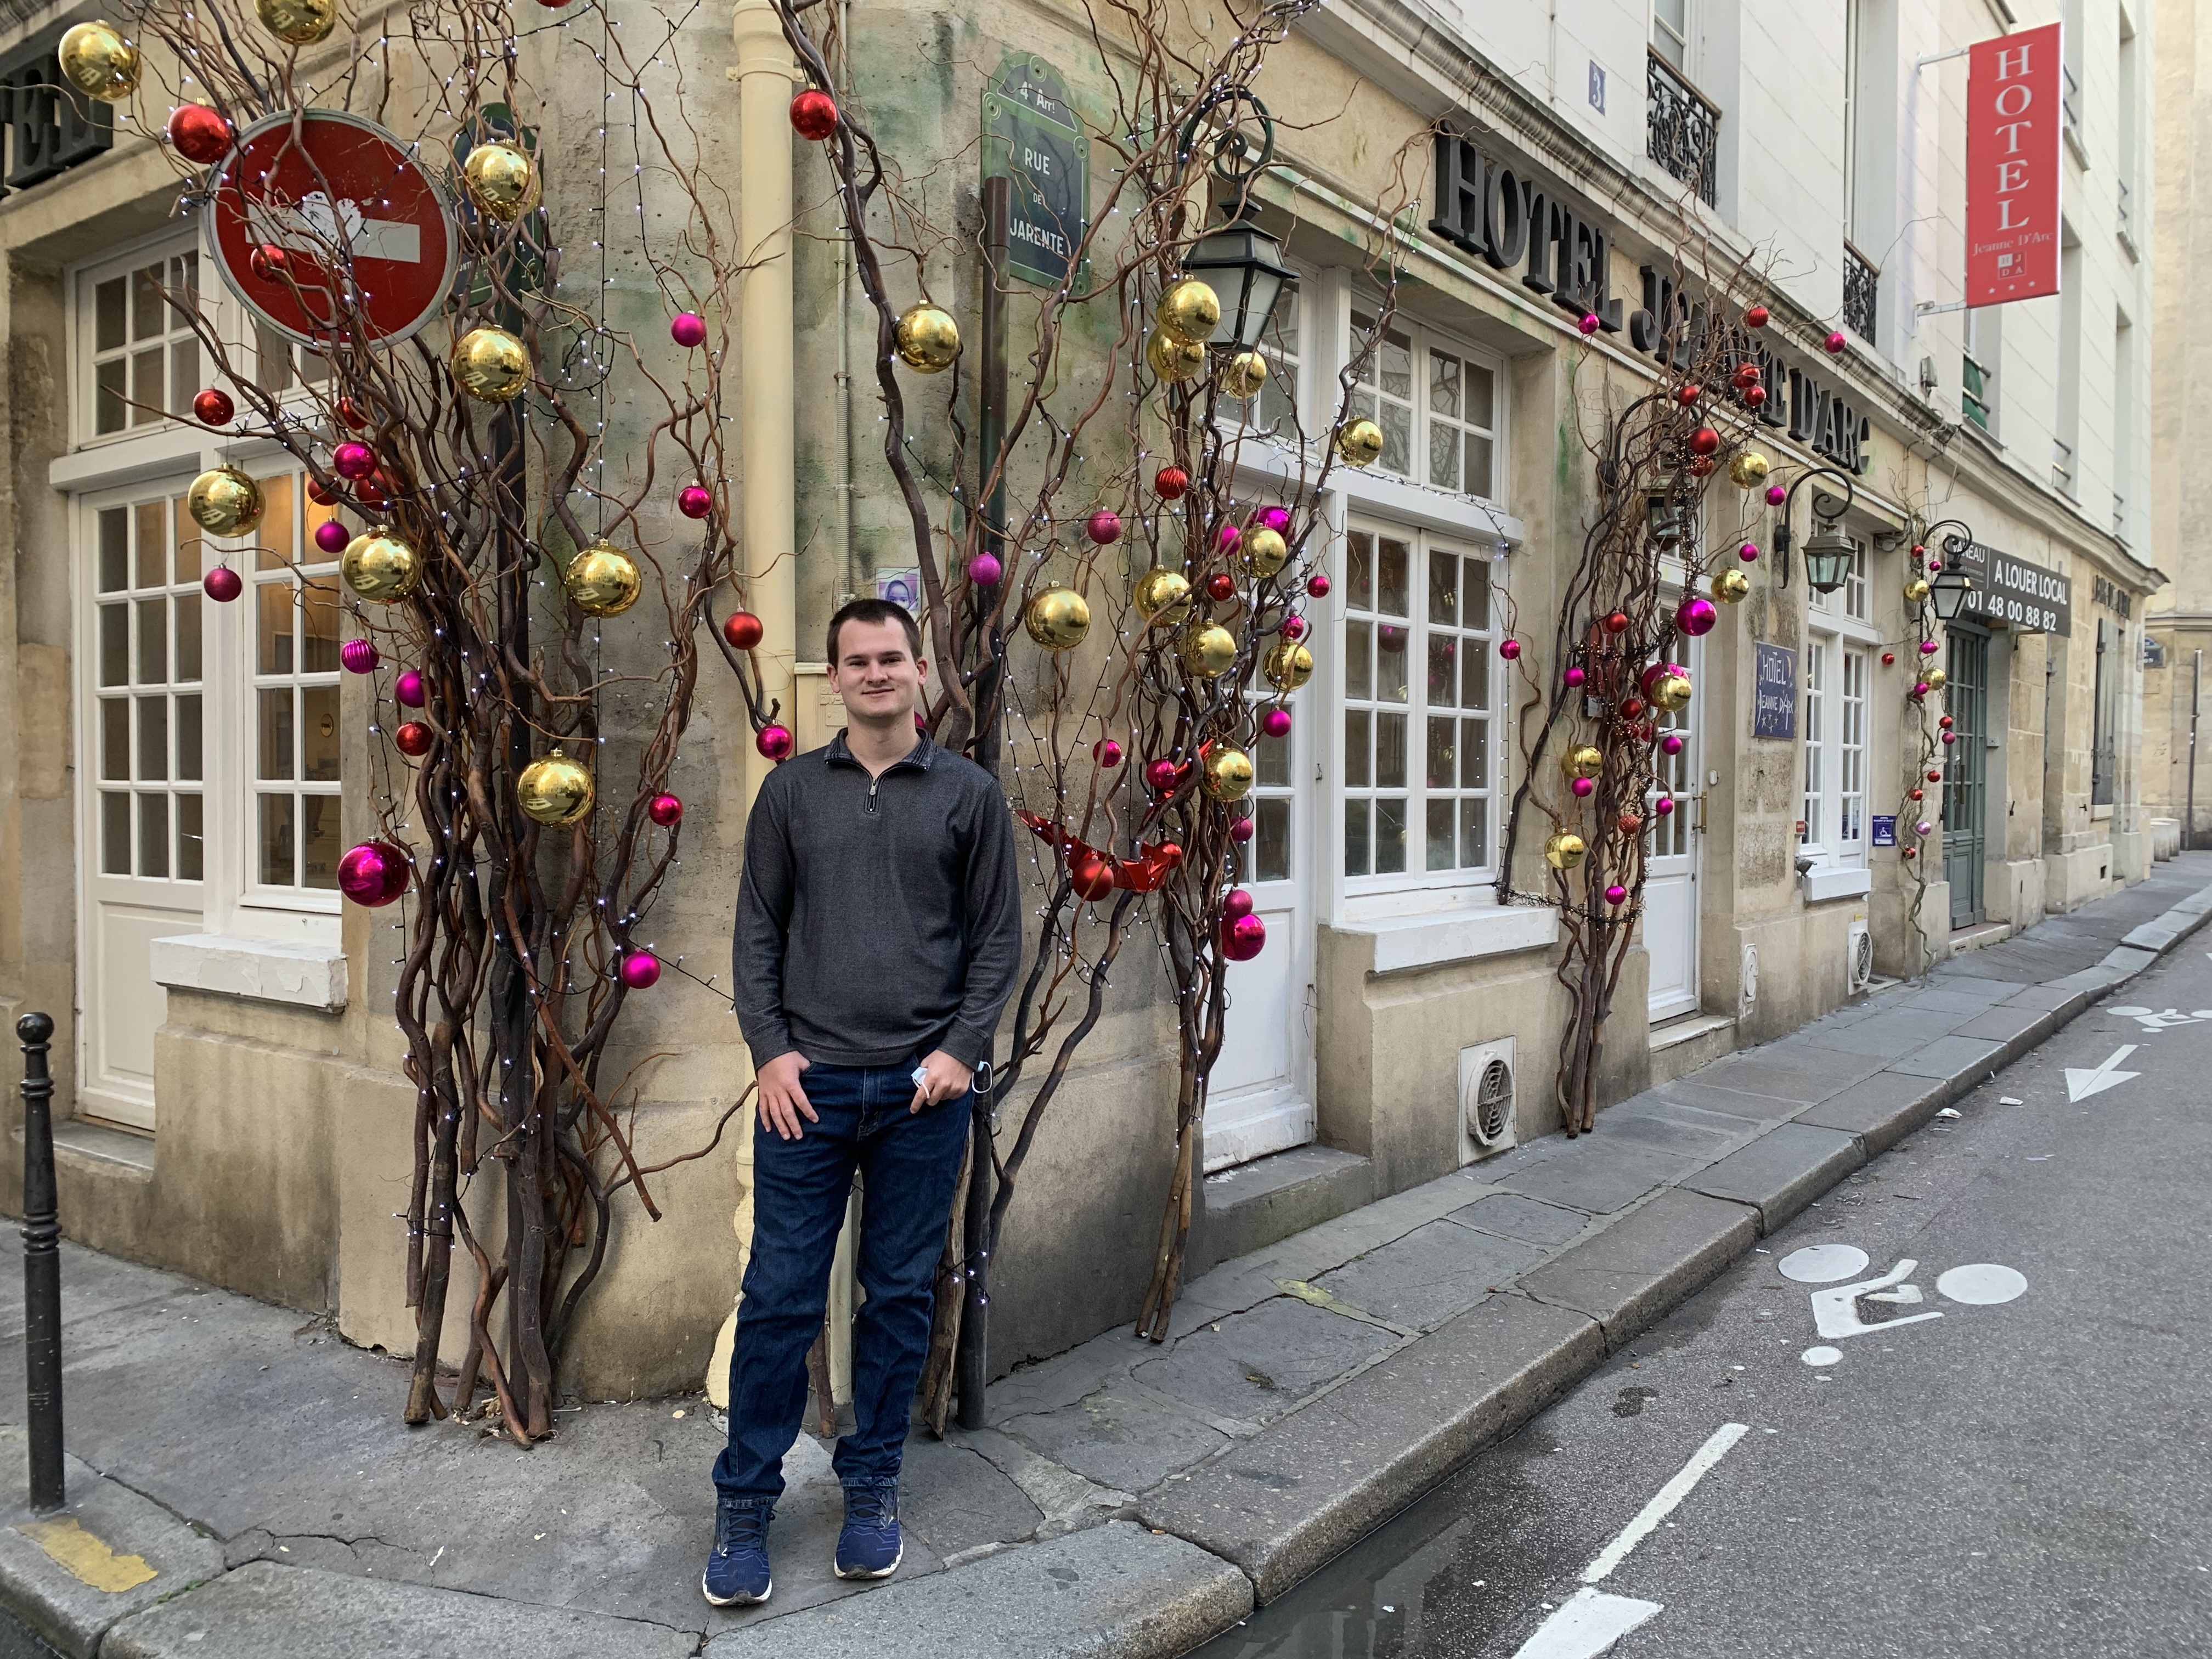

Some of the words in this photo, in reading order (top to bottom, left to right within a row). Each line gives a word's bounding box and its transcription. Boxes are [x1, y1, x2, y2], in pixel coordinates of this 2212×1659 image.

[1593, 72, 1602, 108] 3
[1995, 43, 2034, 231] HOTEL
[1025, 147, 1050, 175] RUE
[1033, 193, 1042, 205] DE
[1010, 218, 1064, 255] JARENTE
[1973, 240, 2013, 257] Jeanne
[2018, 232, 2055, 245] D'Arc
[1429, 121, 1622, 332] HOTEL
[1788, 368, 1870, 475] D'ARC
[1994, 560, 2003, 584] A
[2005, 562, 2038, 595] LOUER
[2039, 574, 2067, 605] LOCAL
[1968, 590, 1983, 611] 01
[1988, 594, 2004, 617] 48
[2007, 600, 2023, 622] 00
[2025, 605, 2040, 627] 88
[2043, 611, 2056, 631] 82
